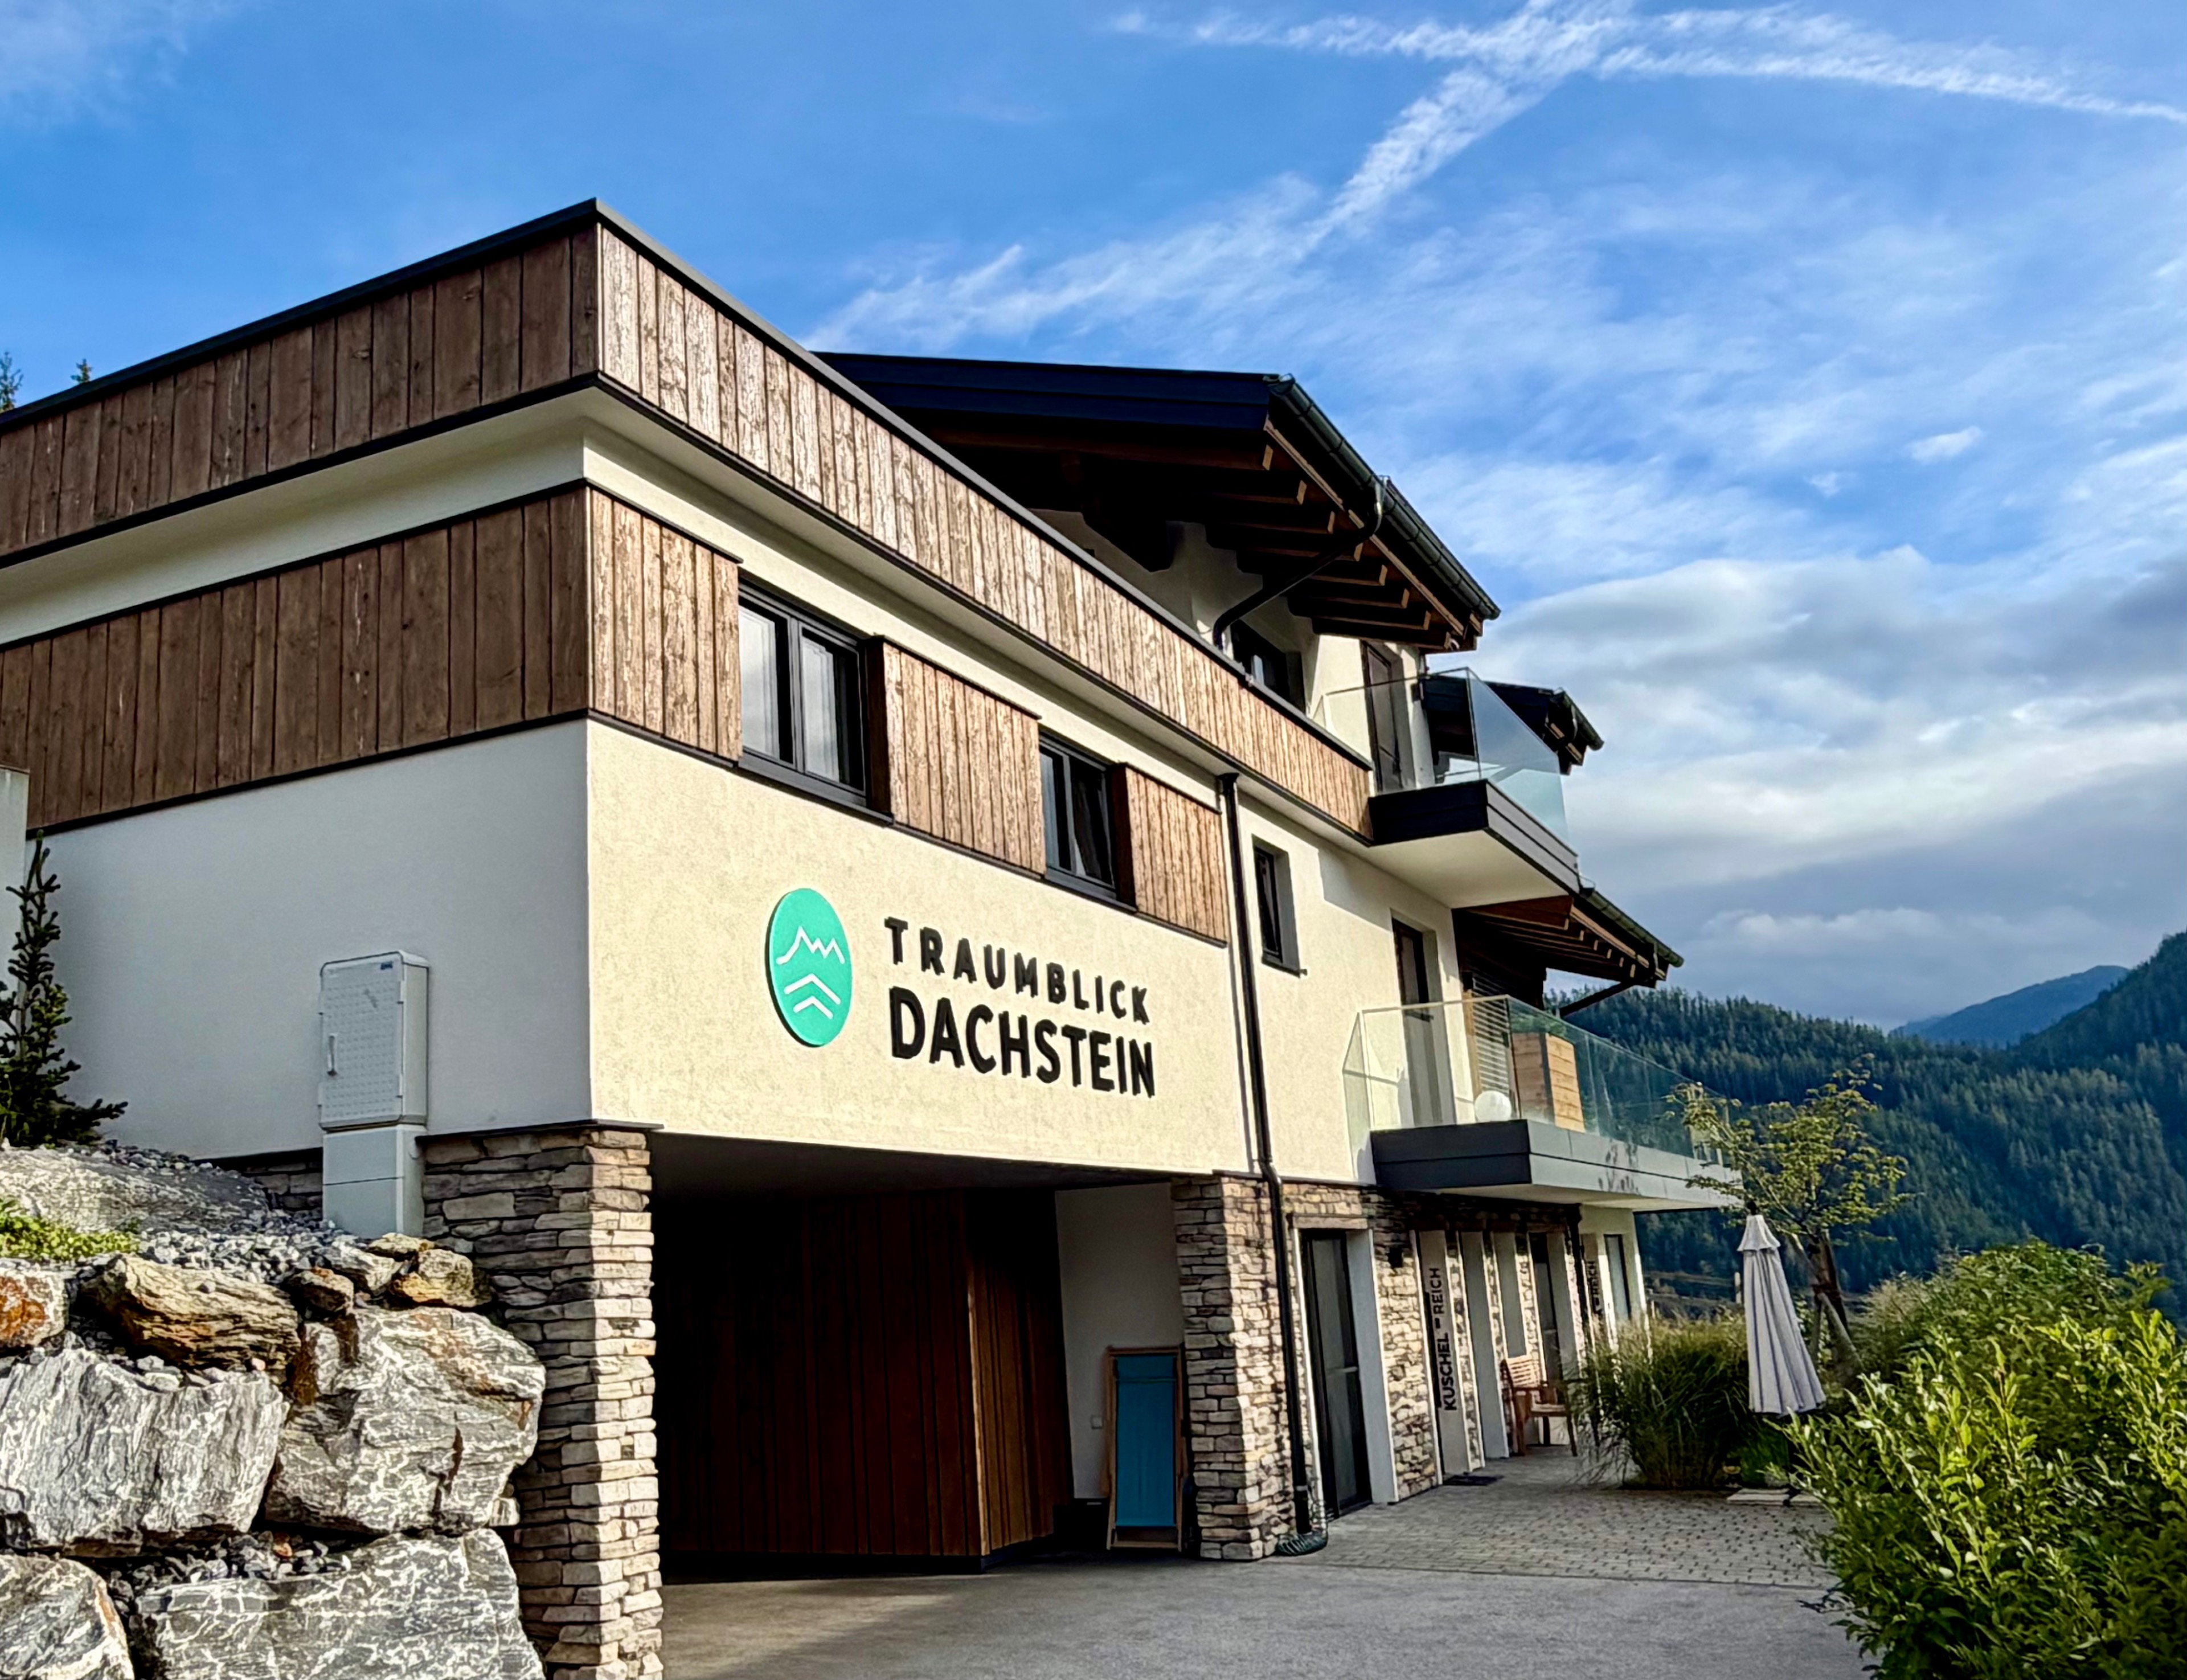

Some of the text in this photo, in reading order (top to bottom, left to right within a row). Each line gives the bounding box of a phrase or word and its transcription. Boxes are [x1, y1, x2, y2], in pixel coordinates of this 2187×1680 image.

[884, 916, 1150, 1025] TRAUMBLICK
[888, 986, 1156, 1099] DACHSTEIN
[1428, 1267, 1445, 1314] REICH
[1437, 1332, 1457, 1411] KUSCHEL
